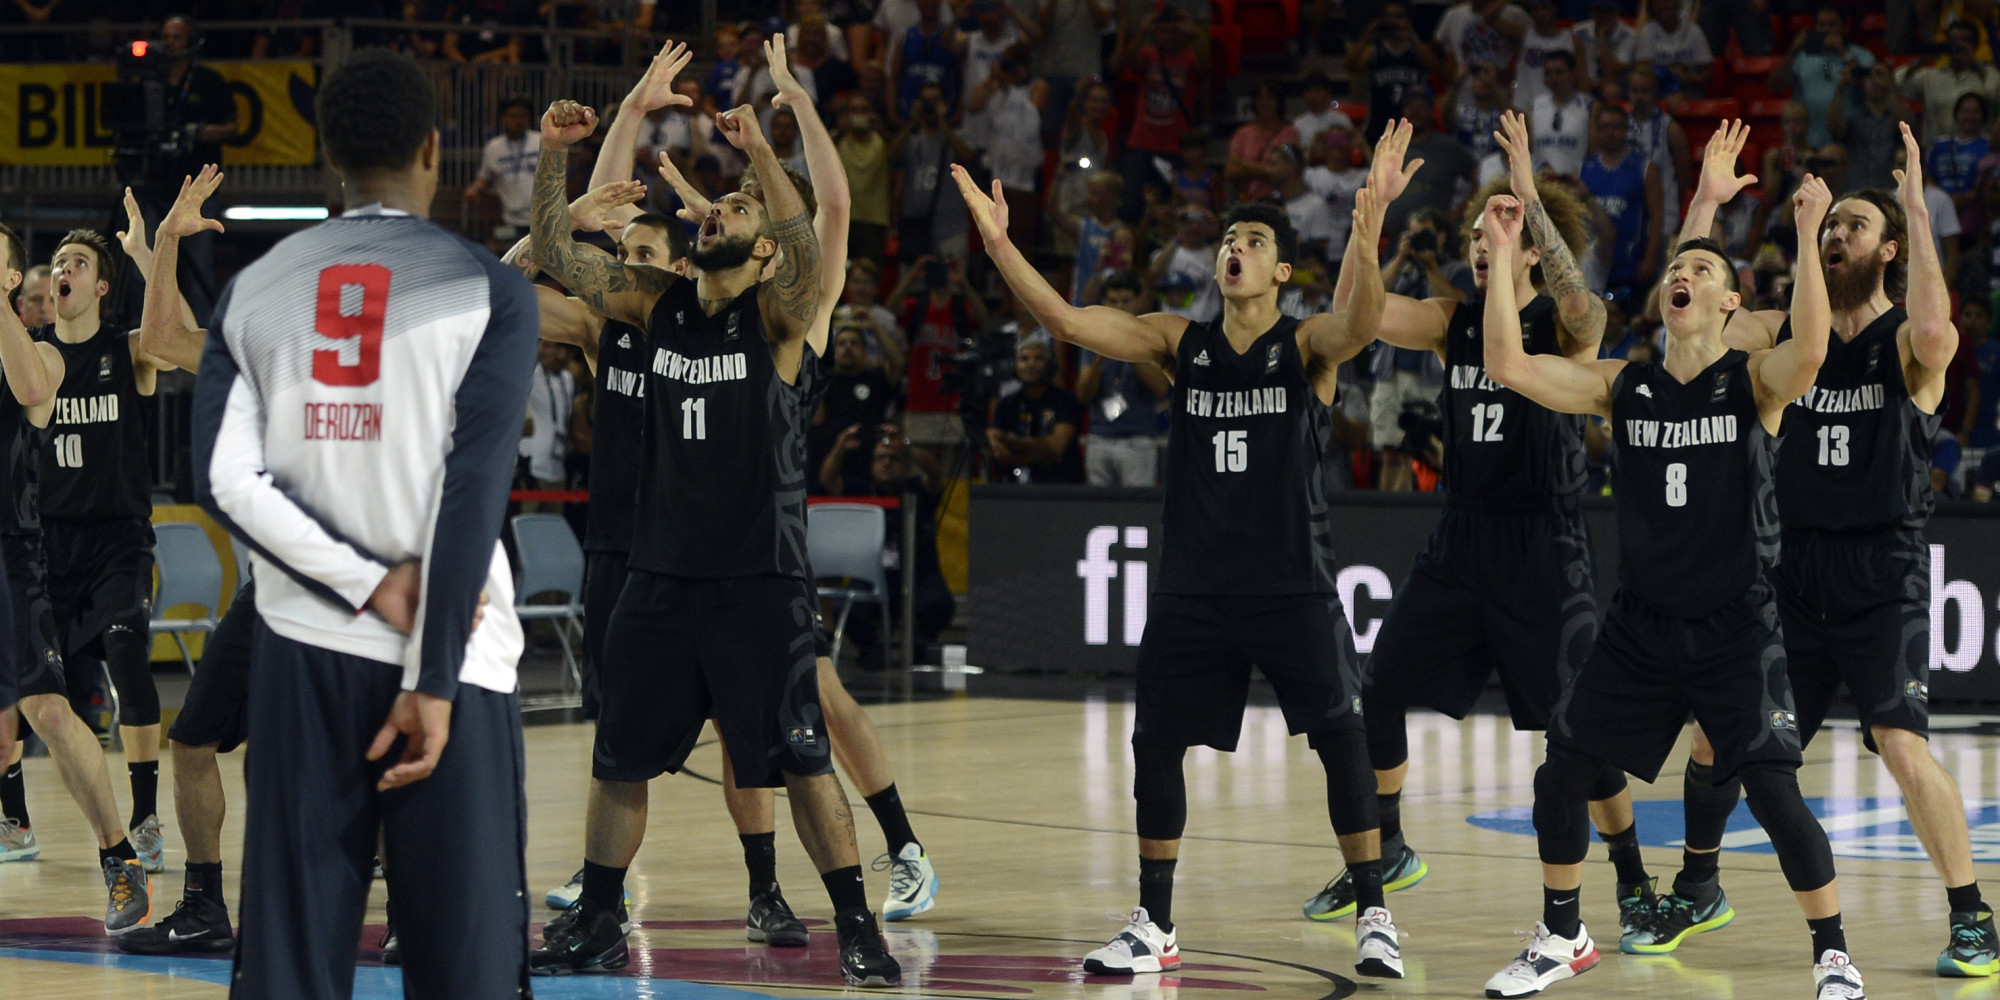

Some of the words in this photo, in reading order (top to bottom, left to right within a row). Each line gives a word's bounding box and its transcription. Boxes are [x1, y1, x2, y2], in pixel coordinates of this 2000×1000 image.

[311, 263, 393, 388] 9
[652, 347, 682, 380] NEW
[682, 352, 748, 385] ZEALAND
[55, 393, 119, 425] ZEALAND
[1215, 386, 1287, 418] ZEALAND
[1815, 383, 1885, 413] ZEALAND
[304, 402, 383, 441] DEROZAN
[681, 397, 706, 440] 11
[1471, 402, 1504, 443] 12
[1626, 419, 1660, 448] NEW
[1661, 414, 1738, 449] ZEALAND
[54, 433, 83, 468] 10
[1212, 430, 1248, 473] 15
[1816, 424, 1850, 467] 13
[1665, 462, 1688, 507] 8
[1928, 543, 2000, 673] b
